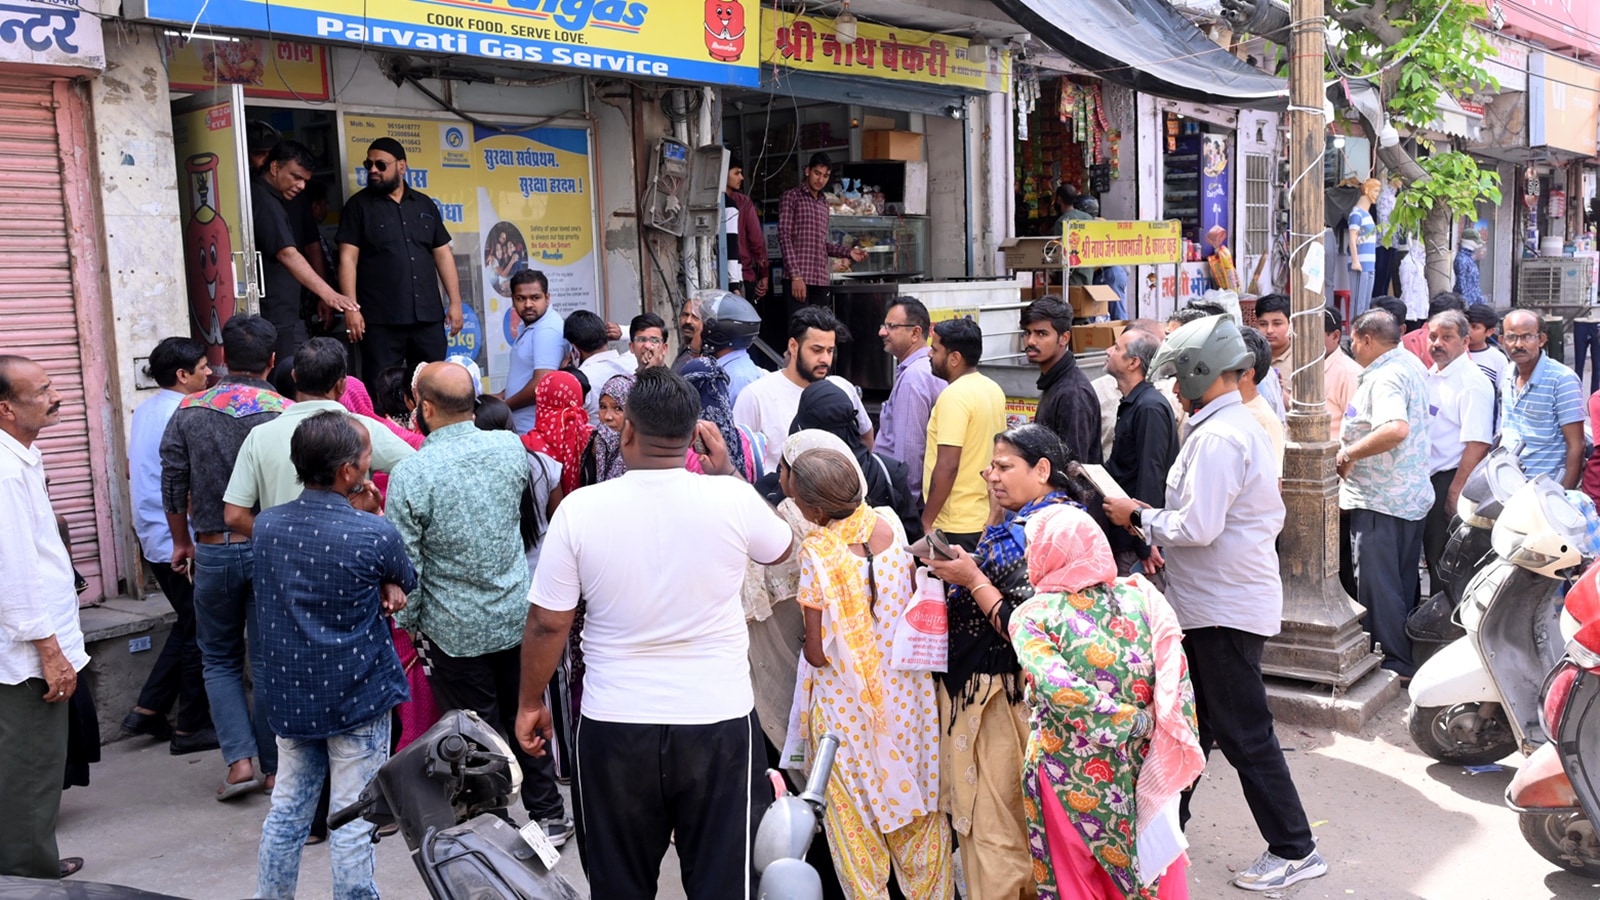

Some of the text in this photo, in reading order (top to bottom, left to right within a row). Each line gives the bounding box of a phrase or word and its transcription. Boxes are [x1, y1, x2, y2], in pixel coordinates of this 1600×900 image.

[0, 4, 80, 54] न्टर
[426, 12, 588, 45] COOK FOOD. SERVE LOVE.
[316, 16, 669, 76] Parvati Gas Service
[776, 20, 950, 78] श्री नाथ बेकरी
[349, 120, 366, 128] Mob.
[483, 146, 560, 171] सुरक्षा सर्वप्रथम.
[518, 176, 549, 198] सुरक्षा
[548, 177, 576, 194] हरदम
[1082, 235, 1090, 259] श्री
[1091, 240, 1105, 258] नाथ
[1116, 233, 1144, 257] पावभाजी
[1145, 235, 1151, 256] &
